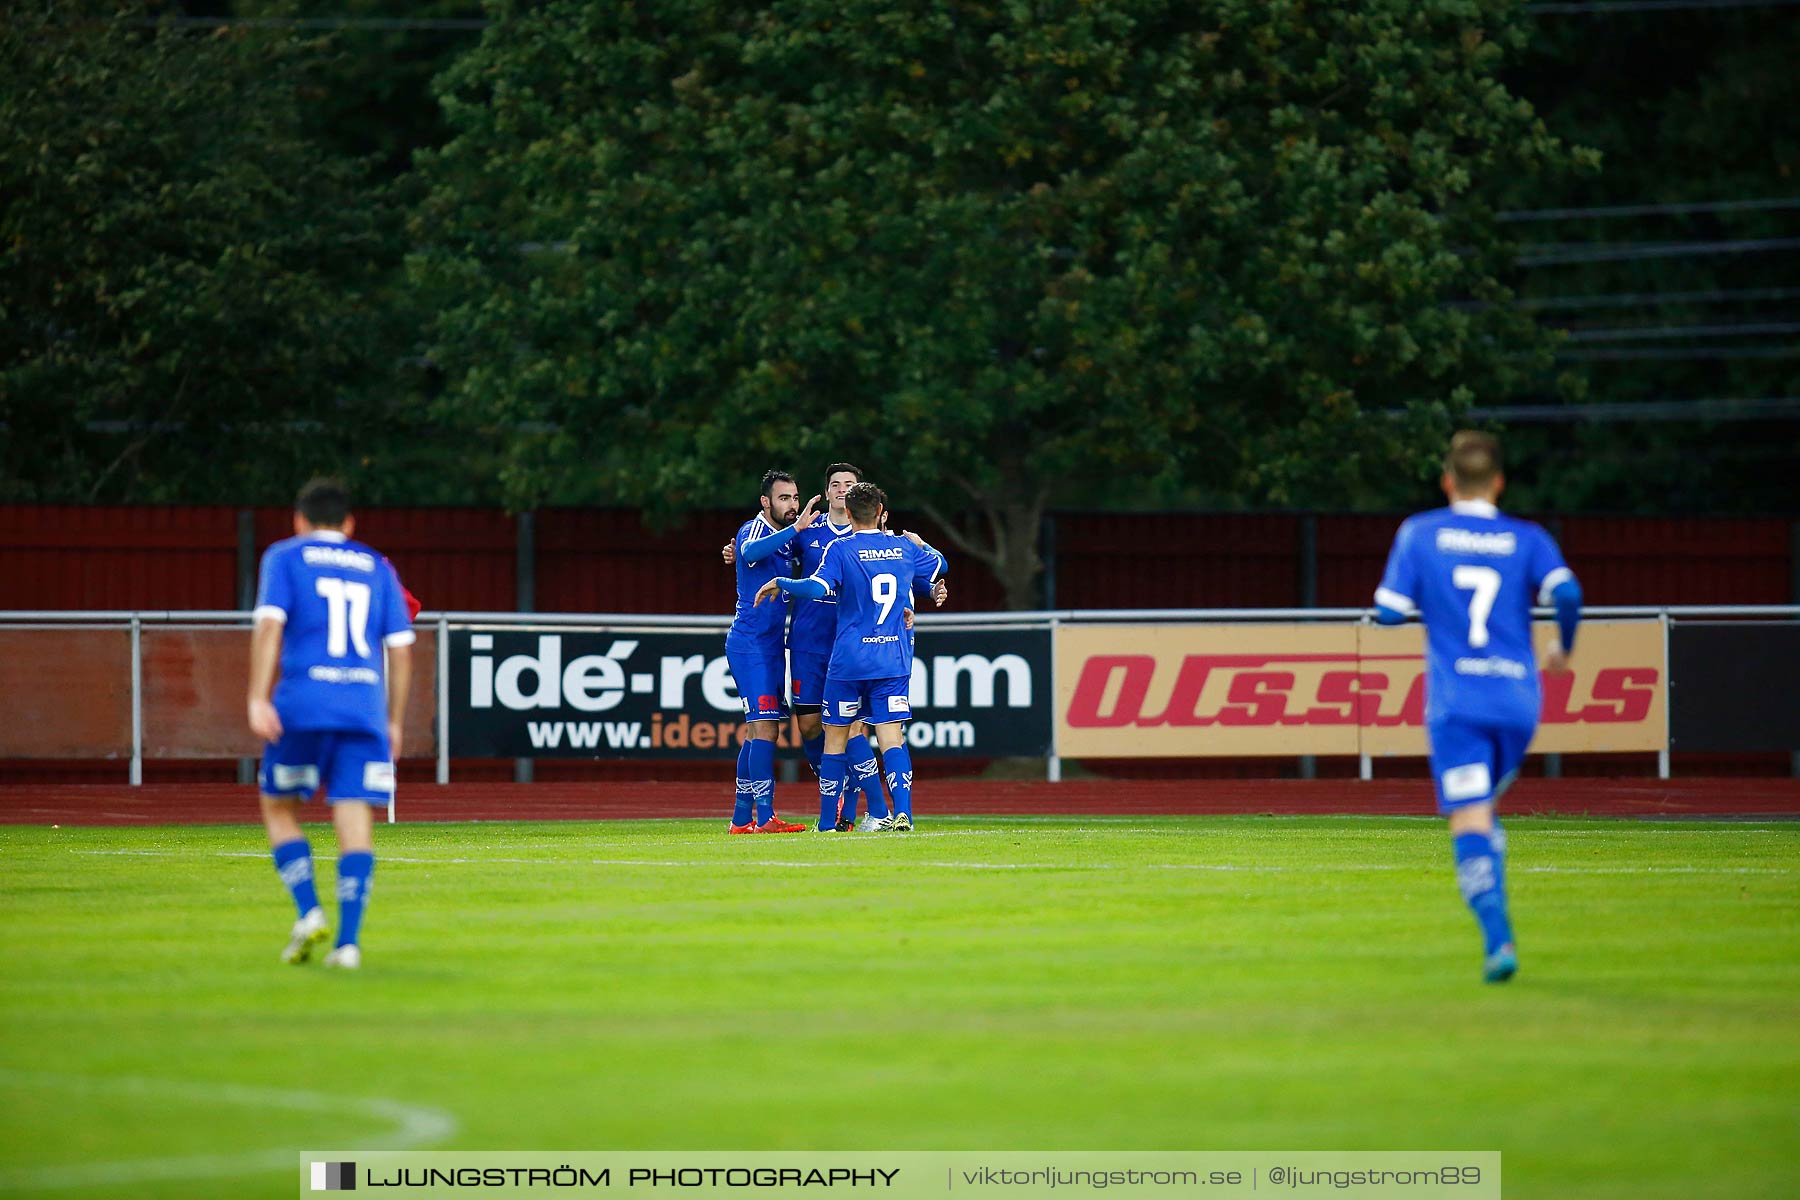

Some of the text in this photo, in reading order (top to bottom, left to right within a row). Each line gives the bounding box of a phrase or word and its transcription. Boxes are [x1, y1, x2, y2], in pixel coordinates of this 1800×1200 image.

[858, 547, 902, 559] RIMAC
[315, 576, 371, 659] 17
[871, 573, 897, 625] 9
[1452, 564, 1502, 648] 7
[470, 634, 1032, 712] idé-rem
